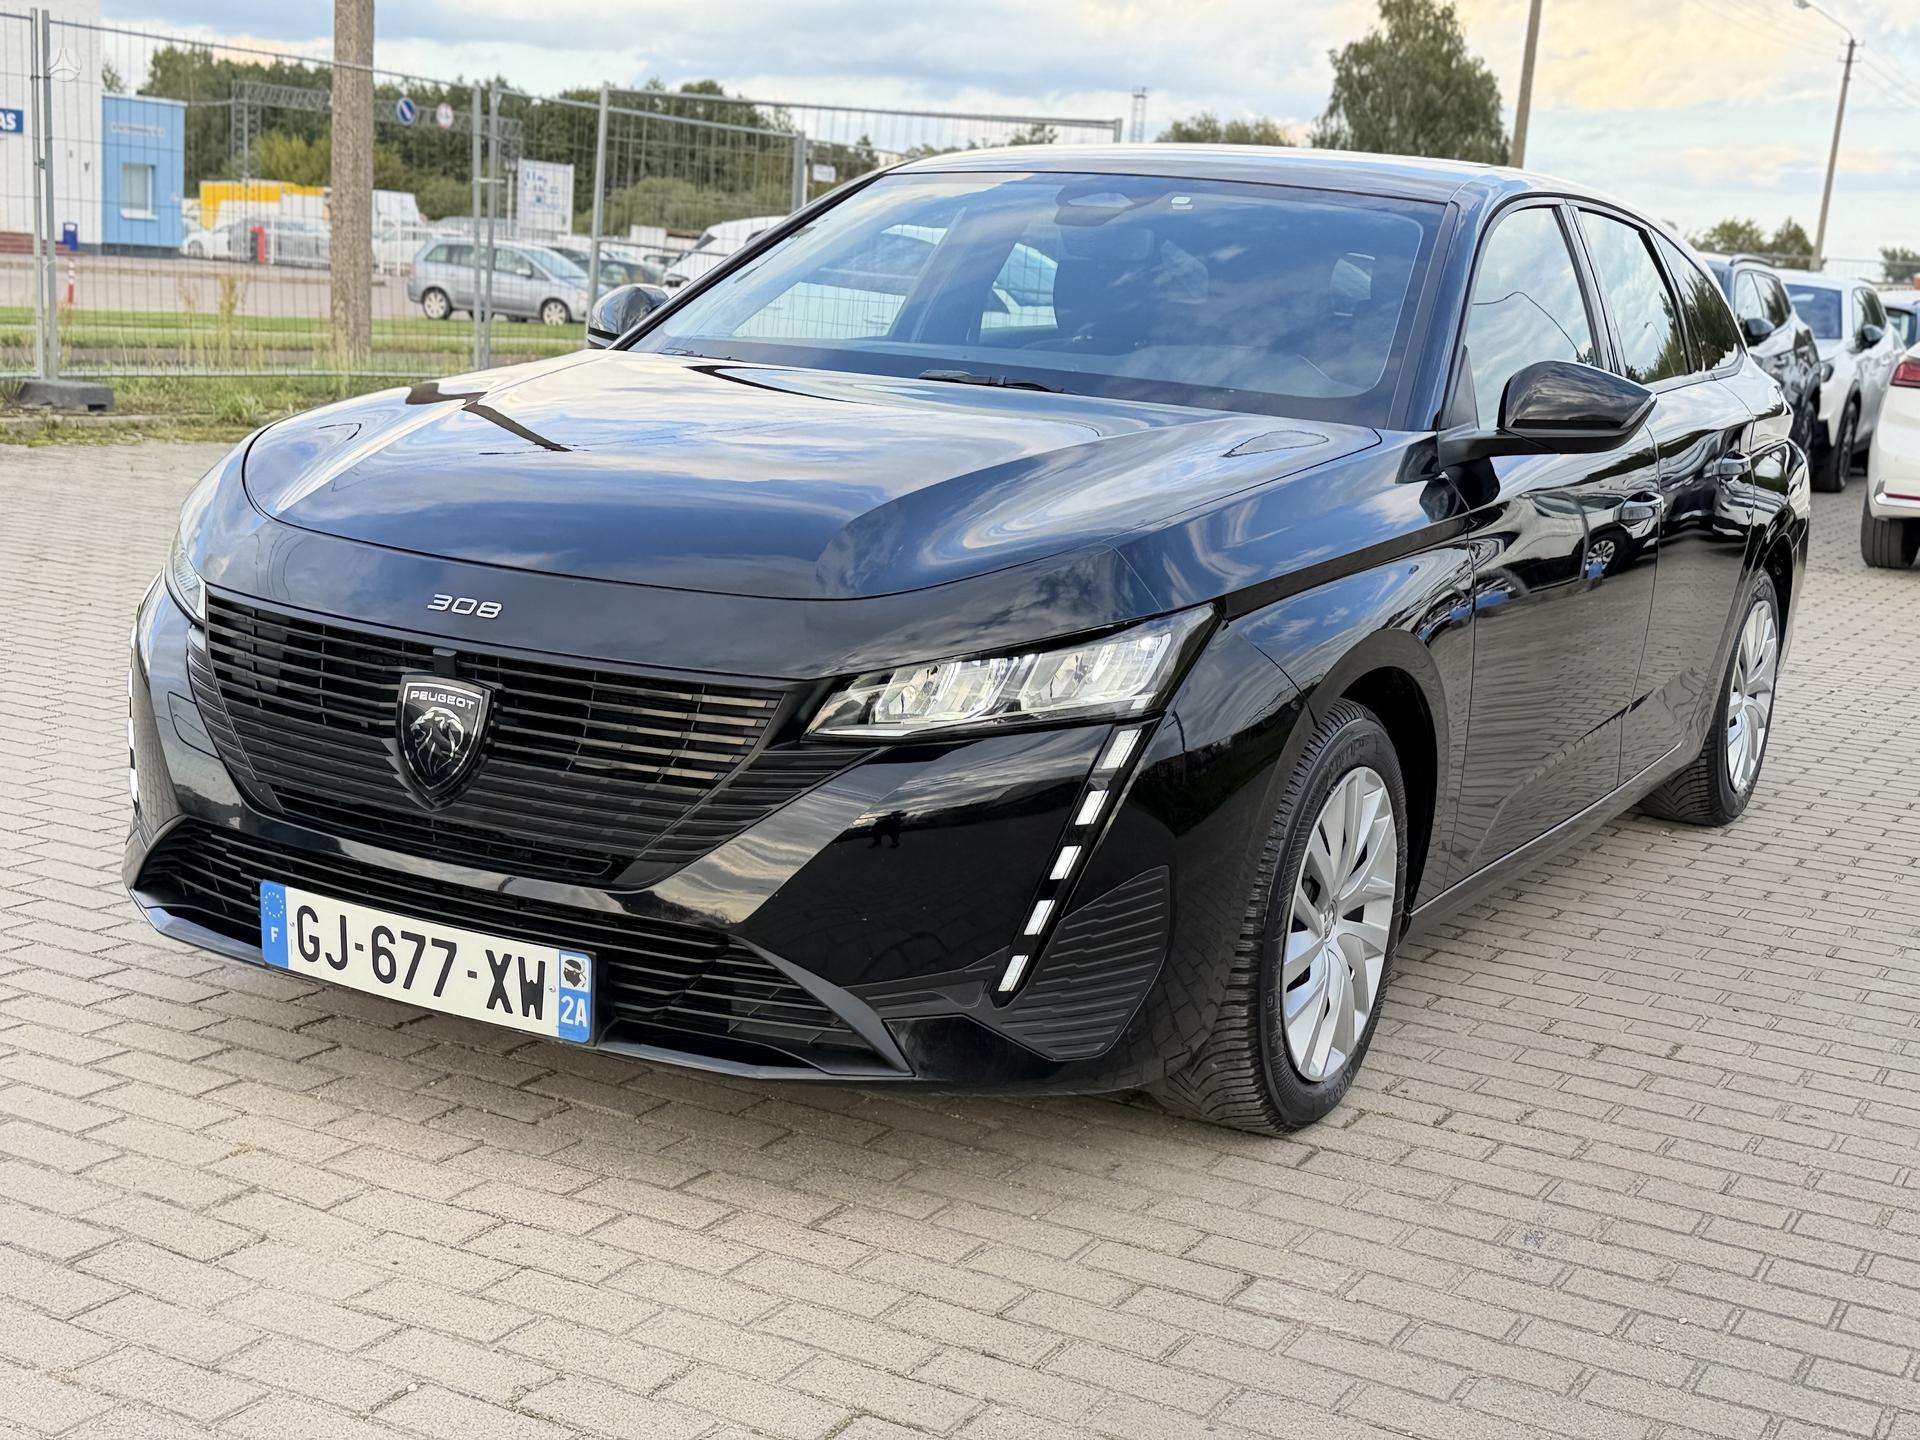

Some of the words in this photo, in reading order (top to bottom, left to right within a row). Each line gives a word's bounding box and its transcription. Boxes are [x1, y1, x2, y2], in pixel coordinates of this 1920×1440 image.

[427, 593, 502, 619] 308
[409, 690, 475, 710] PEUGEOT
[270, 926, 280, 943] F
[296, 905, 546, 1021] GJ-677-XW
[560, 995, 588, 1028] 2A
